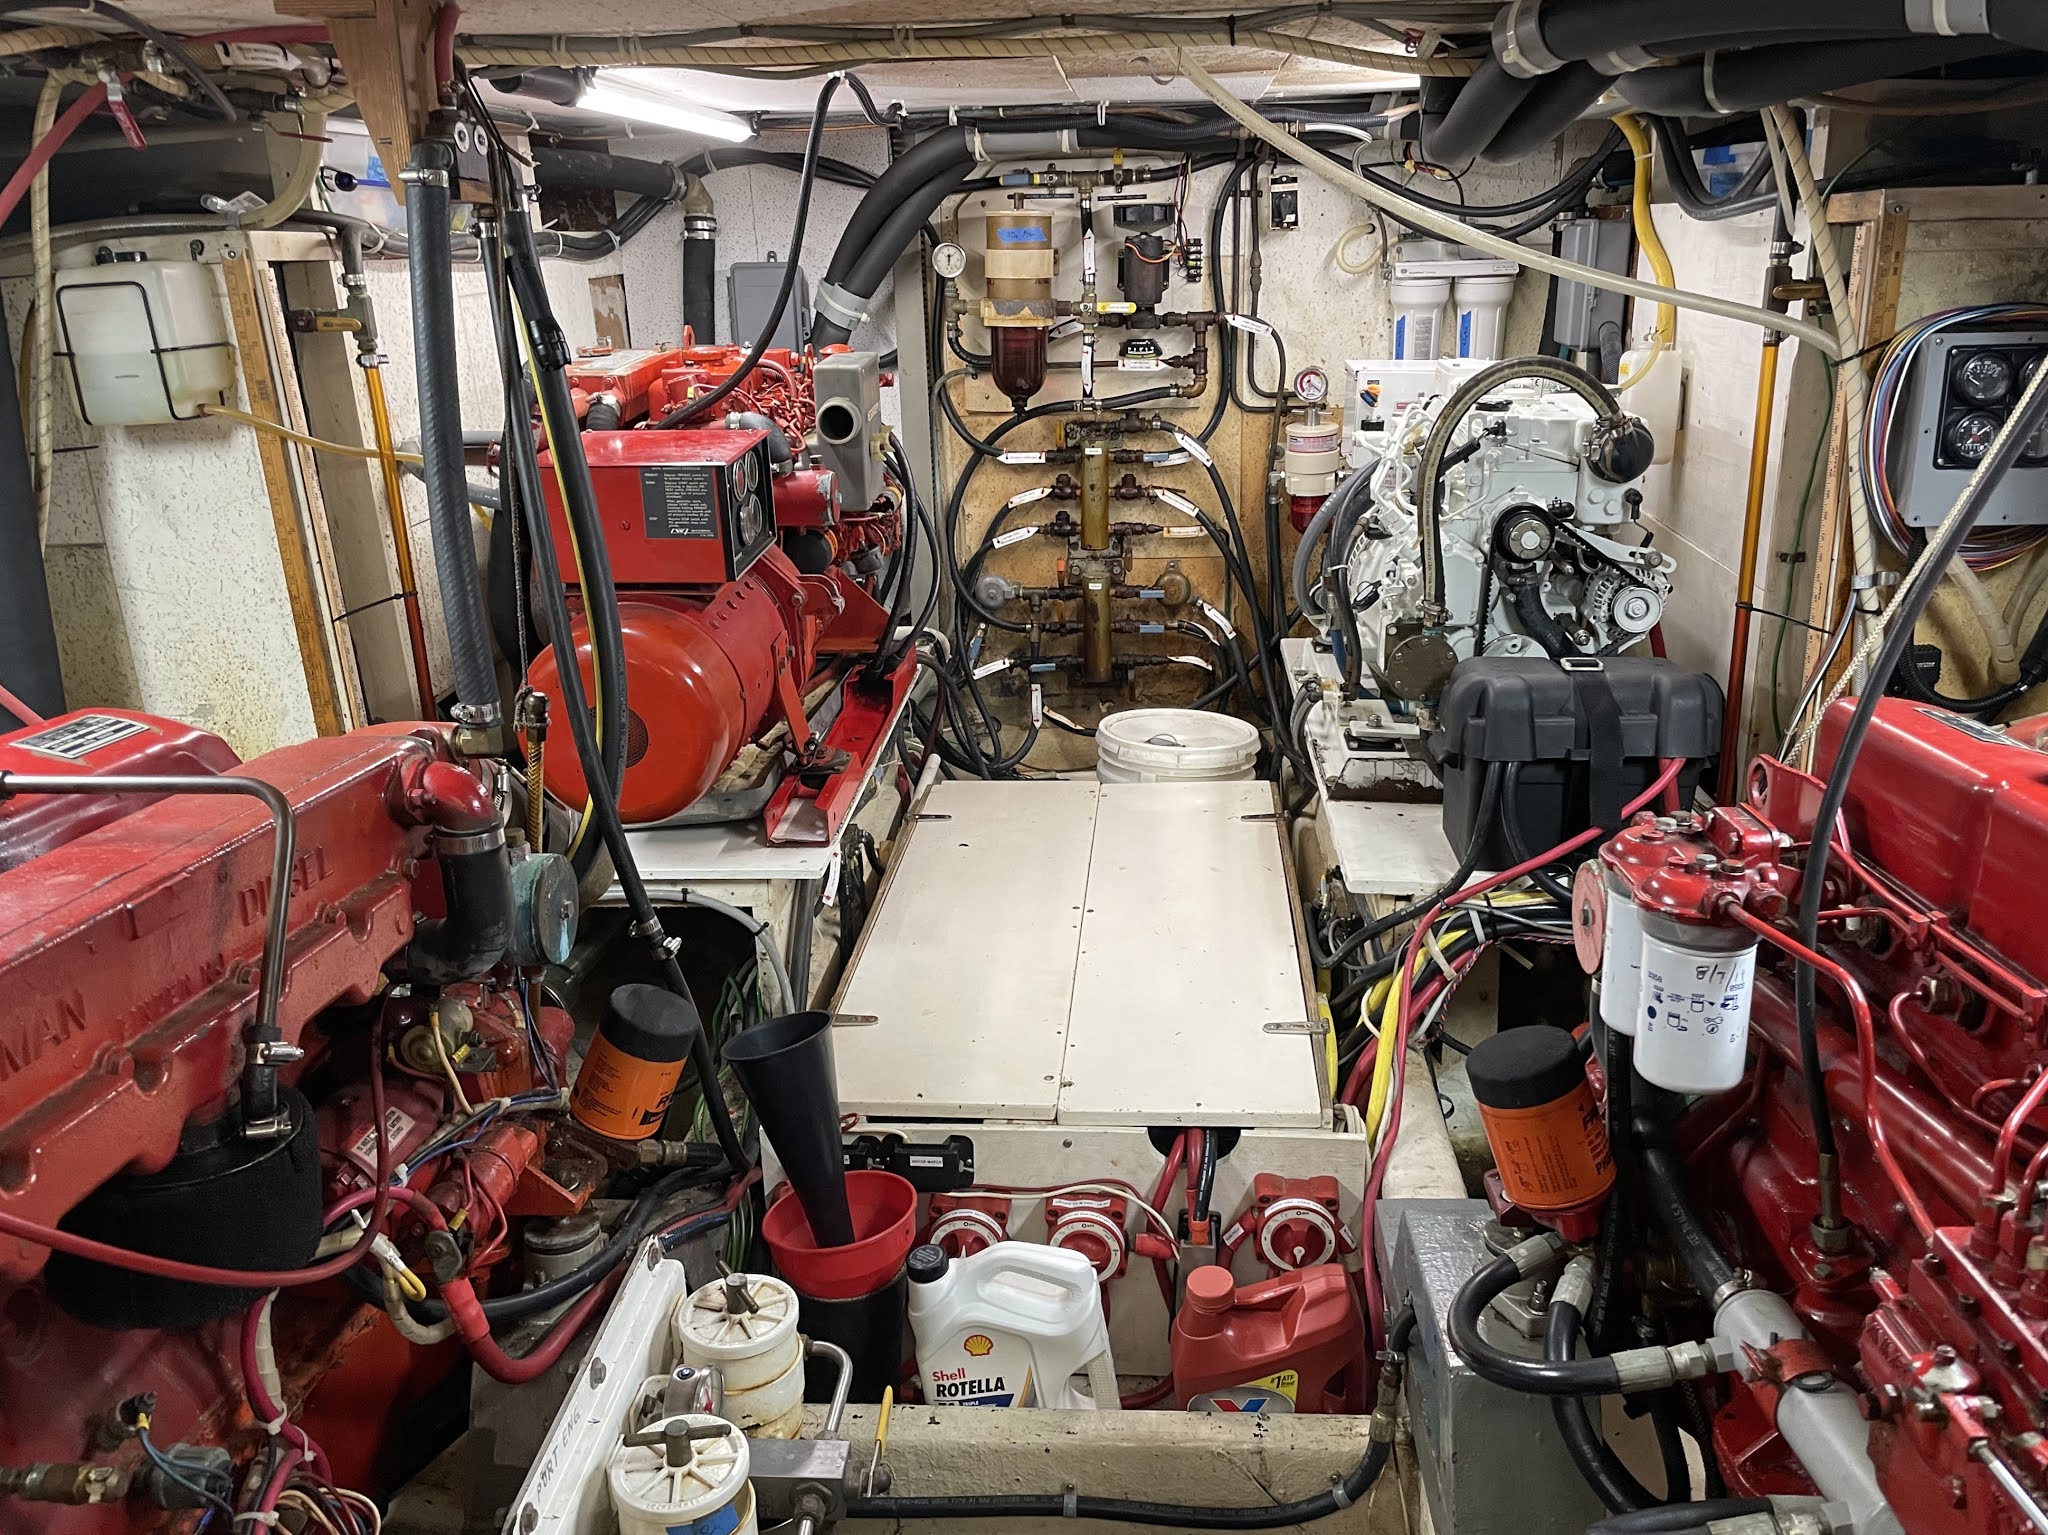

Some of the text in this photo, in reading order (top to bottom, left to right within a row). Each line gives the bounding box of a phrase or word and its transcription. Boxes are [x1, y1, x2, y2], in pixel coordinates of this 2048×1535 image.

[932, 1368, 966, 1382] Shell
[936, 1377, 1005, 1397] ROTELLA
[537, 1408, 582, 1503] PORT ENG
